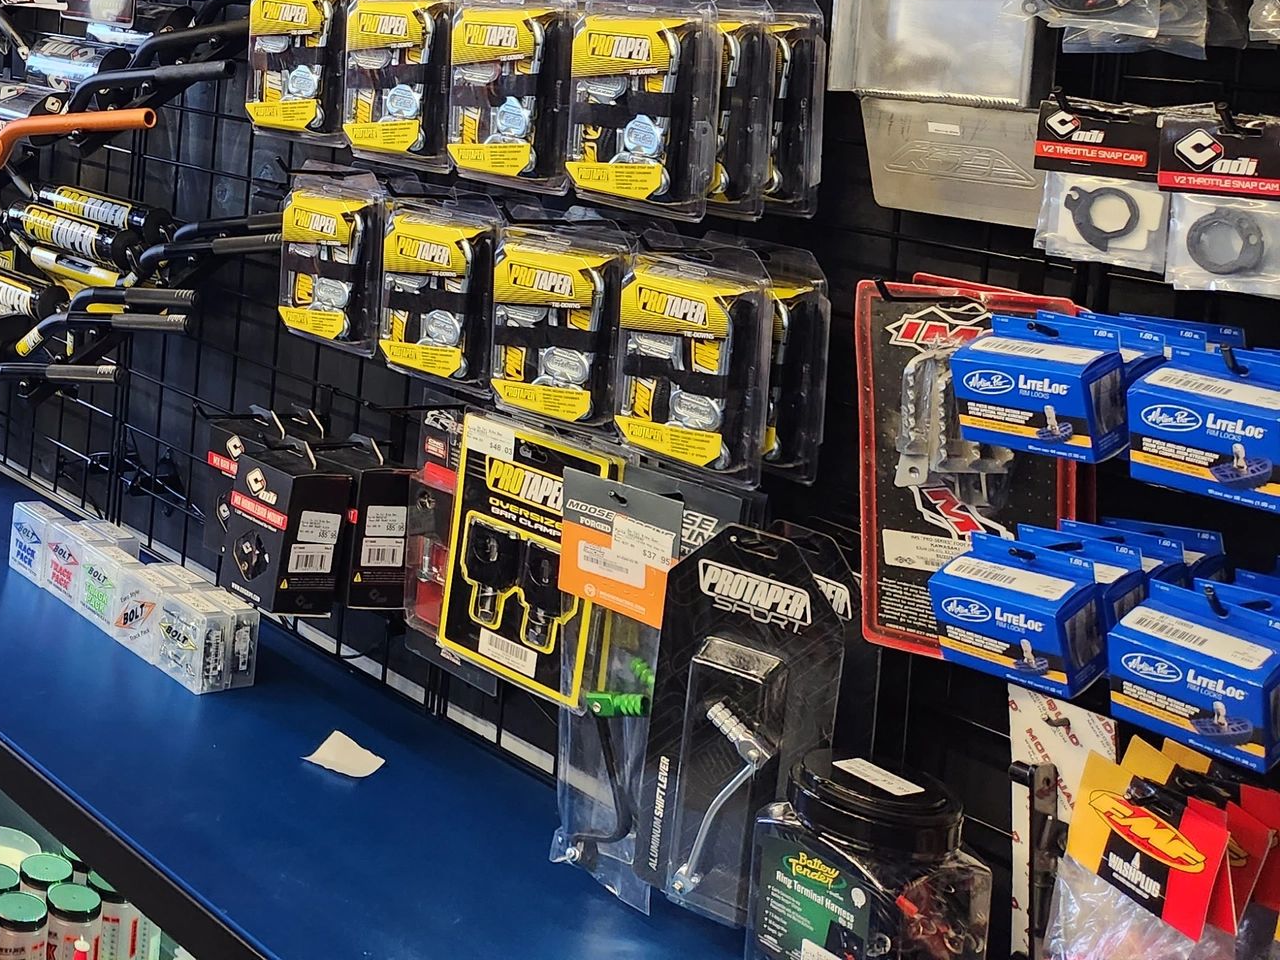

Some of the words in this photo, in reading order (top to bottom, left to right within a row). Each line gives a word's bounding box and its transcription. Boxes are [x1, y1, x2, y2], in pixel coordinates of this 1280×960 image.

[262, 0, 308, 23] PROTAPER
[359, 12, 408, 37] PROTAPER
[465, 24, 517, 48] PROTAPER
[589, 34, 651, 61] PROTAPER
[1042, 144, 1054, 153] V2
[1055, 145, 1097, 158] THROTTLE
[1097, 149, 1122, 160] SNAP
[1122, 152, 1144, 162] CAM
[1173, 175, 1187, 185] V2
[1187, 176, 1230, 188] THROTTLE
[1230, 179, 1258, 190] SNAP
[1258, 181, 1280, 191] CAM
[294, 207, 337, 236] PROTAPER
[398, 236, 450, 266] PROTAPER
[511, 264, 573, 297] PROTAPER
[639, 288, 708, 326] PROTAPER
[683, 331, 715, 339] TIE-DOWNS
[1031, 391, 1050, 400] LOCKS
[628, 424, 663, 442] PROTAPER
[1219, 430, 1242, 443] LOCKS
[491, 506, 517, 522] BAR
[568, 499, 614, 521] MOOSE
[17, 526, 35, 540] BOLT
[579, 516, 612, 533] FORGED
[15, 538, 37, 559] TRACK
[16, 550, 33, 568] PACK
[52, 544, 73, 561] BOLT
[50, 559, 73, 581] TRACK
[51, 571, 69, 590] PACK
[87, 566, 109, 584] BOLT
[703, 564, 806, 620] PROTAPER
[122, 603, 145, 625] BOLT
[712, 595, 802, 636] SPORT
[165, 625, 189, 644] BOLT
[1006, 622, 1025, 635] LOCKS
[1200, 688, 1223, 701] LOCKS
[658, 755, 670, 790] LEVER
[654, 787, 666, 819] SHIFT
[1089, 792, 1207, 866] FMF
[648, 816, 662, 872] ALUMINUM
[788, 858, 834, 889] Tender
[799, 851, 840, 879] Battery
[1108, 852, 1161, 898] WASHPLUG
[775, 870, 794, 889] Ring
[793, 878, 824, 906] Terminal
[825, 897, 855, 923] Harness
